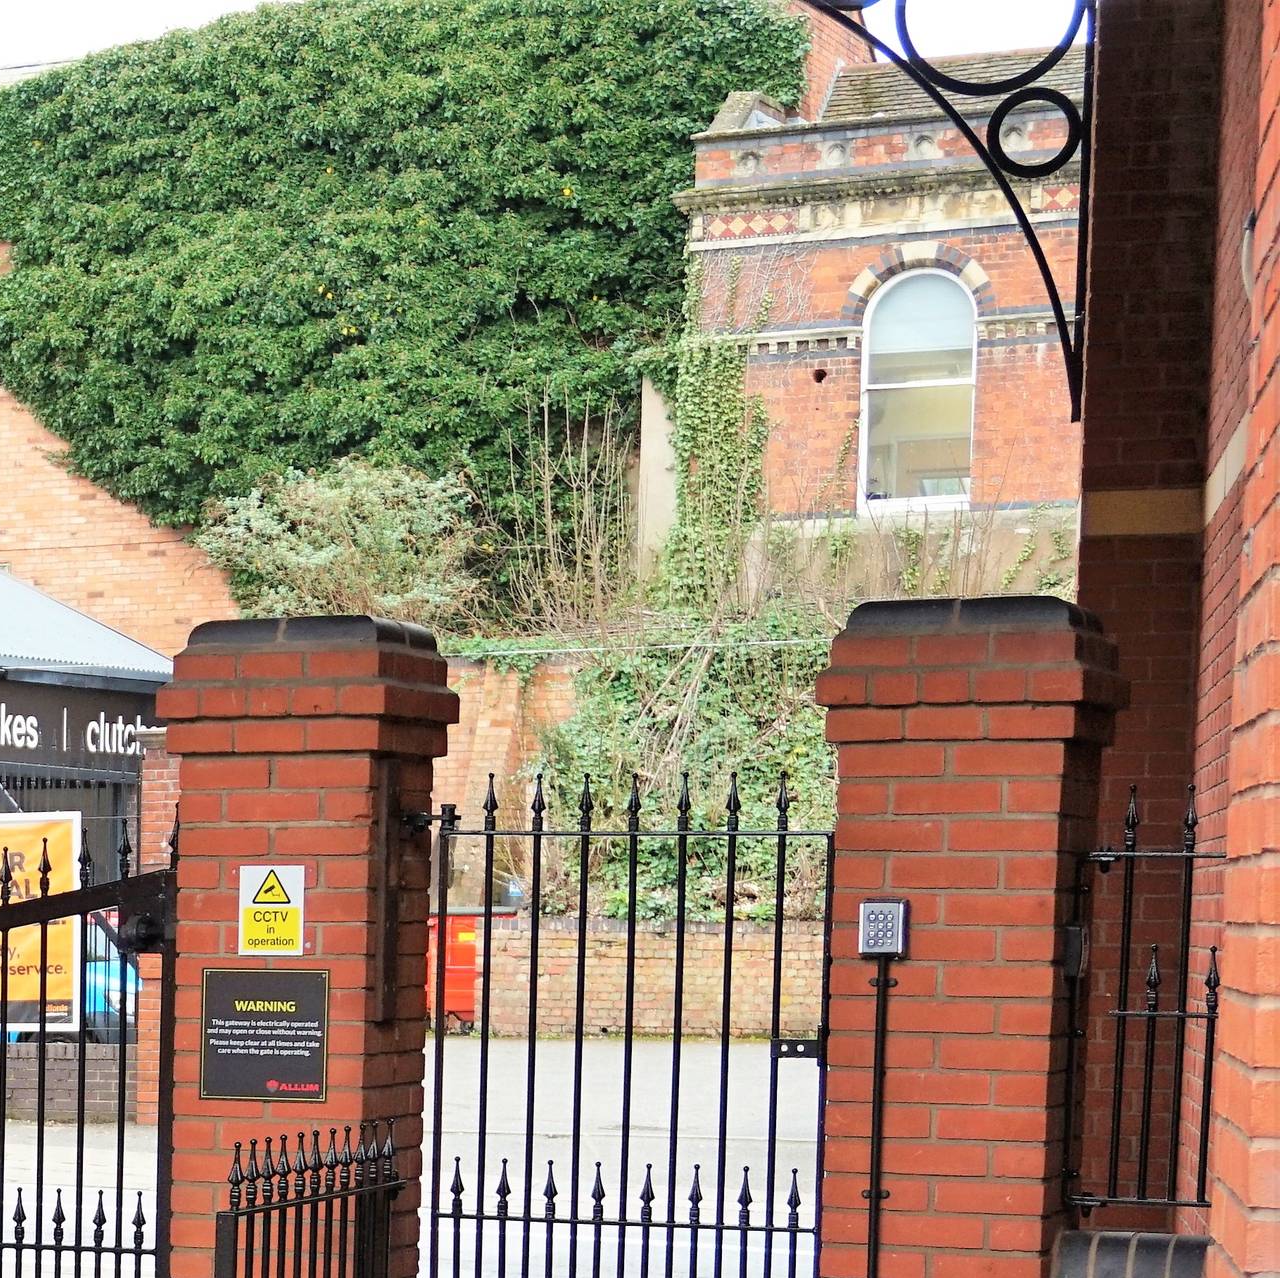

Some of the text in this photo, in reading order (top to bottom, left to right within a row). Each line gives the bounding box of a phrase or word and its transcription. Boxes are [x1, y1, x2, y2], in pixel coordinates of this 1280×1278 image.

[253, 910, 289, 923] CCTV
[266, 924, 275, 934] in
[247, 936, 295, 948] operation
[8, 963, 68, 976] servce.
[234, 1000, 297, 1013] WARNING
[211, 1018, 319, 1029] This gateway is electrically operated
[219, 1028, 231, 1036] may
[272, 1028, 296, 1036] without
[296, 1029, 323, 1037] warning.
[209, 1038, 229, 1046] Please
[230, 1039, 245, 1047] keep
[306, 1040, 320, 1048] take
[249, 1047, 259, 1055] the
[280, 1048, 311, 1057] operating.
